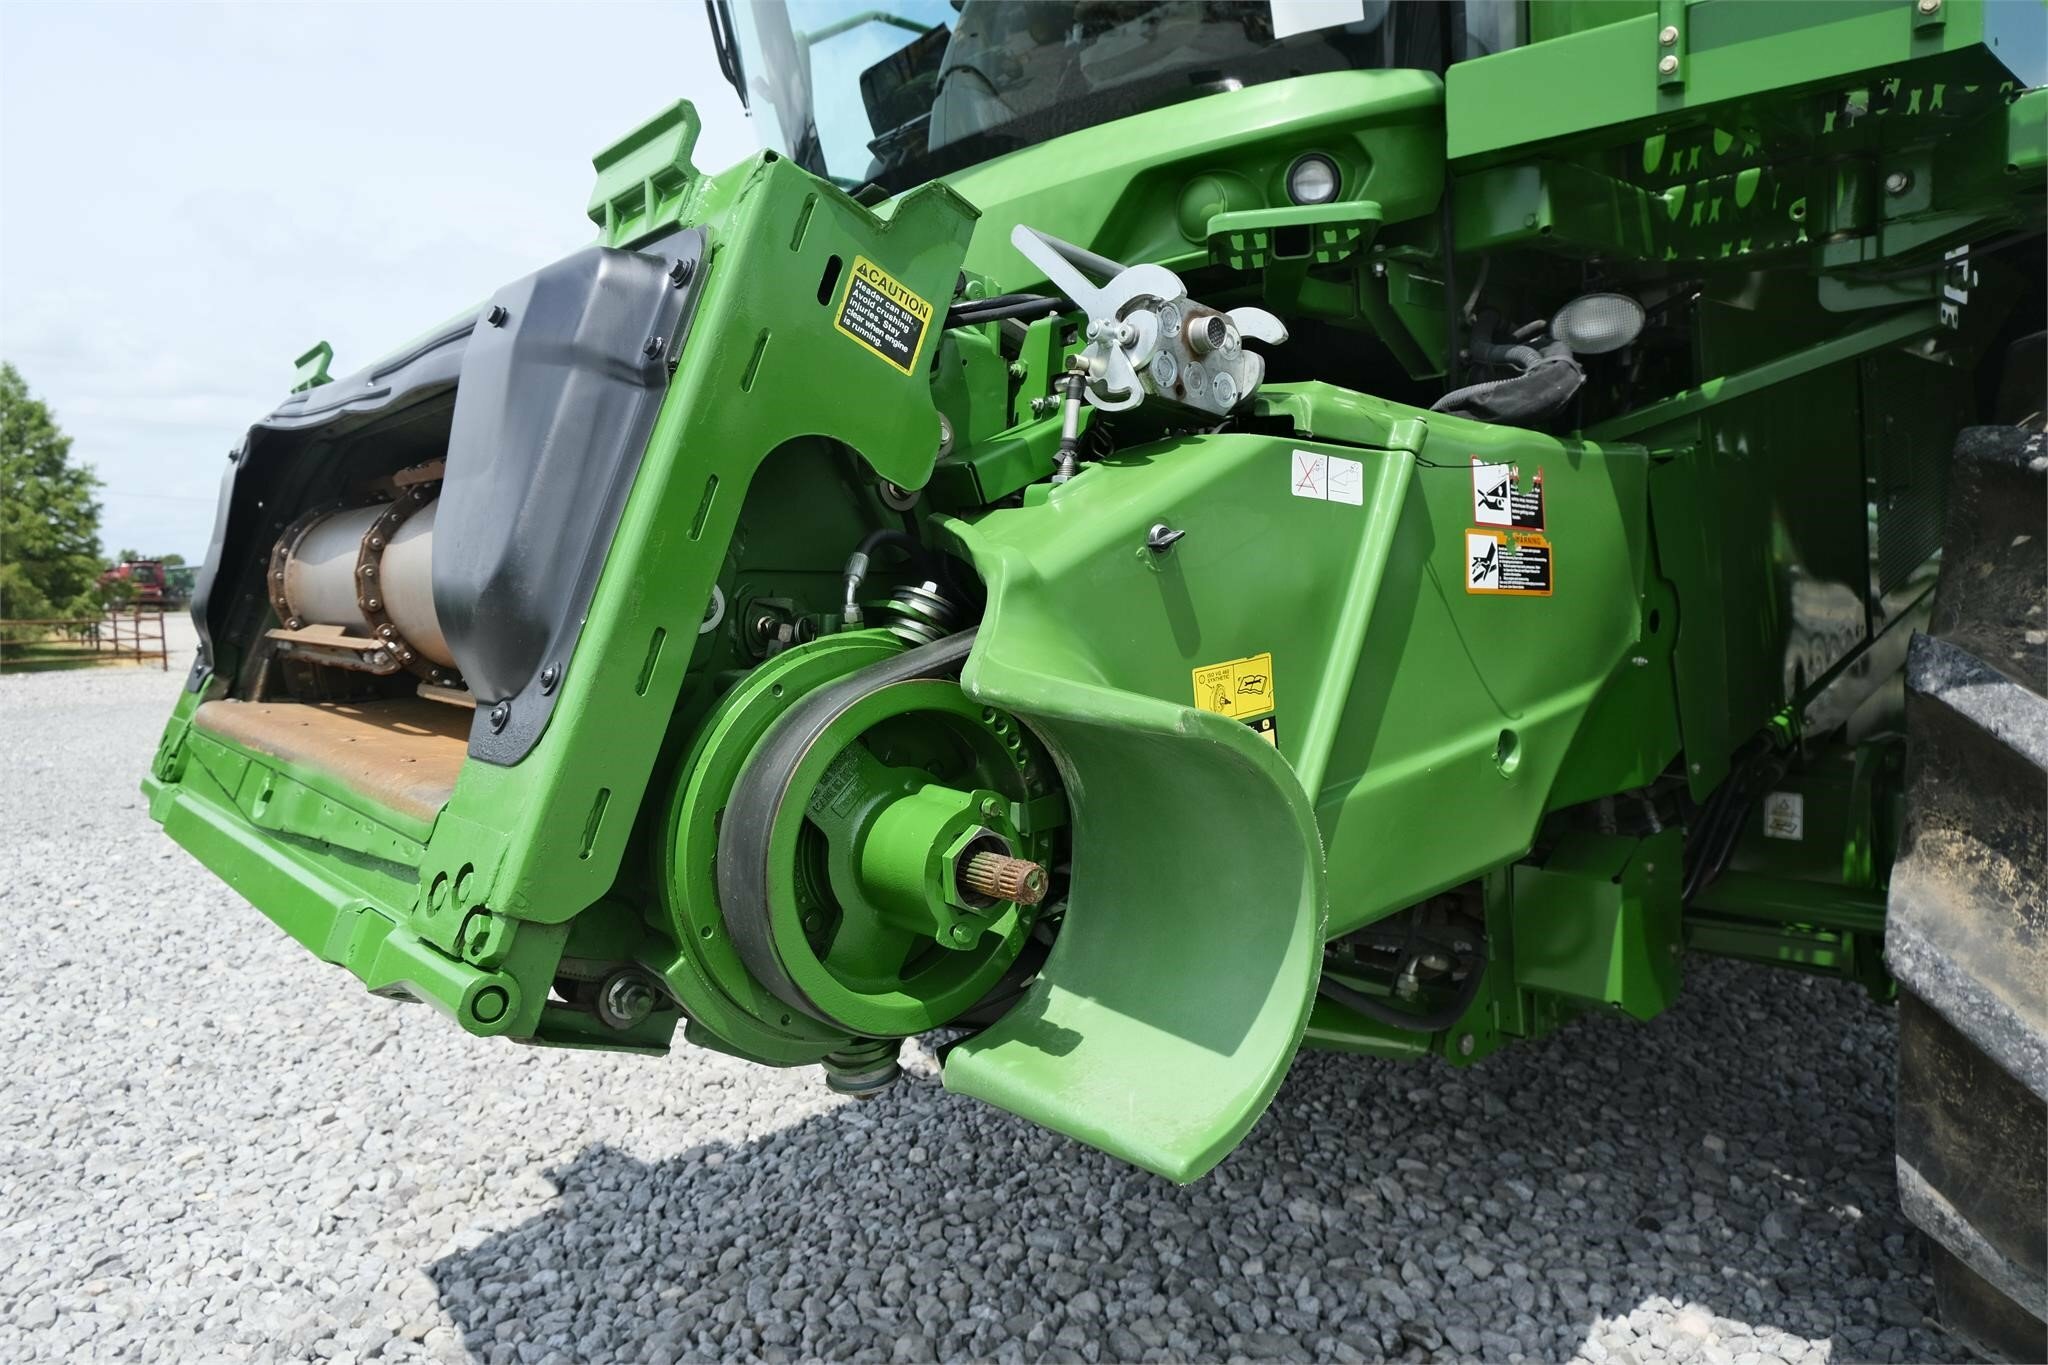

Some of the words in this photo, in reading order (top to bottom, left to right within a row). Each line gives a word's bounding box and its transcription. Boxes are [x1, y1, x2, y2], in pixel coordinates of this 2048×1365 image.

[852, 289, 875, 309] Avoid
[876, 303, 910, 334] crushing
[855, 279, 884, 303] Header
[885, 301, 900, 317] can
[901, 311, 914, 325] tilt.
[869, 269, 928, 318] CAUTION
[843, 315, 851, 325] is
[851, 322, 882, 347] running.
[846, 308, 865, 323] clear
[865, 319, 885, 337] when
[884, 334, 909, 353] engine
[849, 298, 881, 324] injuries.
[882, 320, 901, 337] Stay
